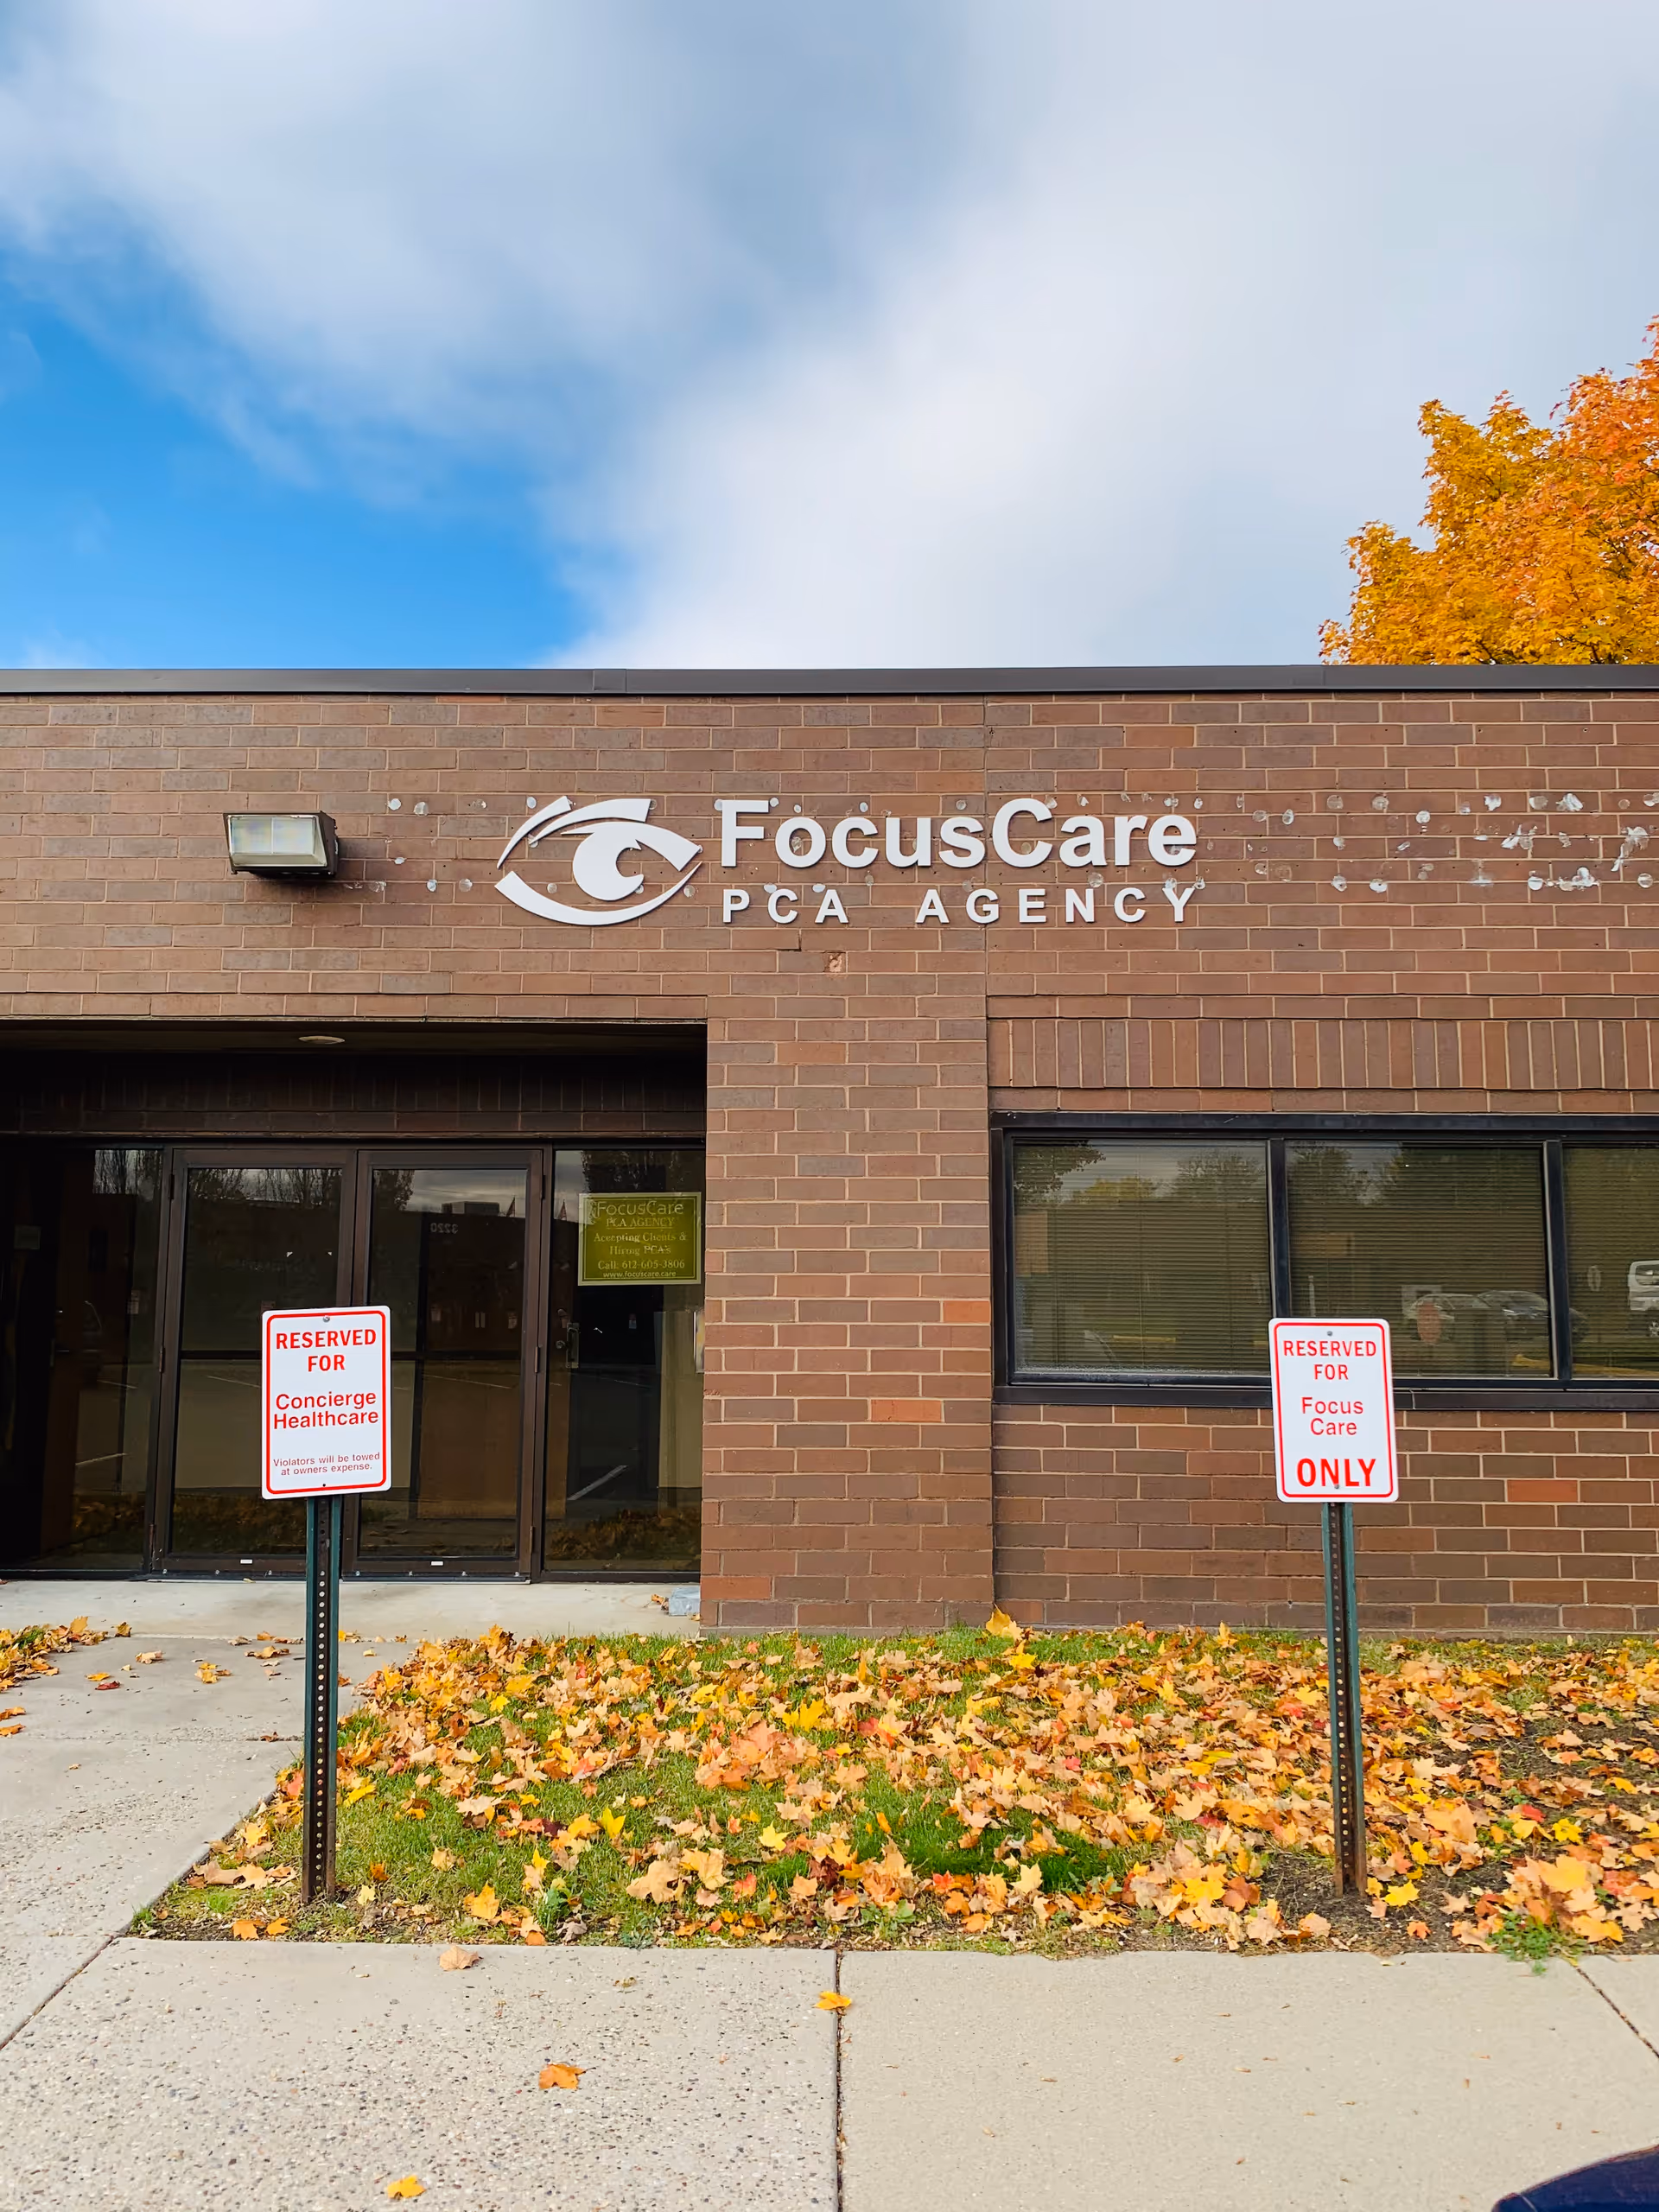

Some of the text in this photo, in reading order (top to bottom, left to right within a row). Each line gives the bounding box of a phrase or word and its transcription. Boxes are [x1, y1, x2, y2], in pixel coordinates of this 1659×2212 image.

[720, 798, 1197, 868] FocusCare
[722, 887, 1195, 925] PCA AGENCY
[596, 1200, 684, 1217] FocusCare
[606, 1217, 676, 1228] PCA AGENCY
[593, 1232, 687, 1243] Accepting Clients &
[609, 1245, 641, 1255] Hiring
[621, 1259, 685, 1269] 612-605-3806
[276, 1329, 377, 1350] RESERVED
[1283, 1340, 1377, 1357] RESERVED
[308, 1354, 346, 1372] FOR
[1313, 1363, 1350, 1381] FOR
[276, 1391, 377, 1412] Concierge
[1301, 1396, 1364, 1414] Focus
[274, 1410, 379, 1430] Healthcare
[1310, 1417, 1357, 1436] Care
[273, 1452, 380, 1467] Violators will be towed
[293, 1465, 327, 1475] owners
[331, 1463, 372, 1473] expense.
[1296, 1458, 1376, 1488] ONLY
